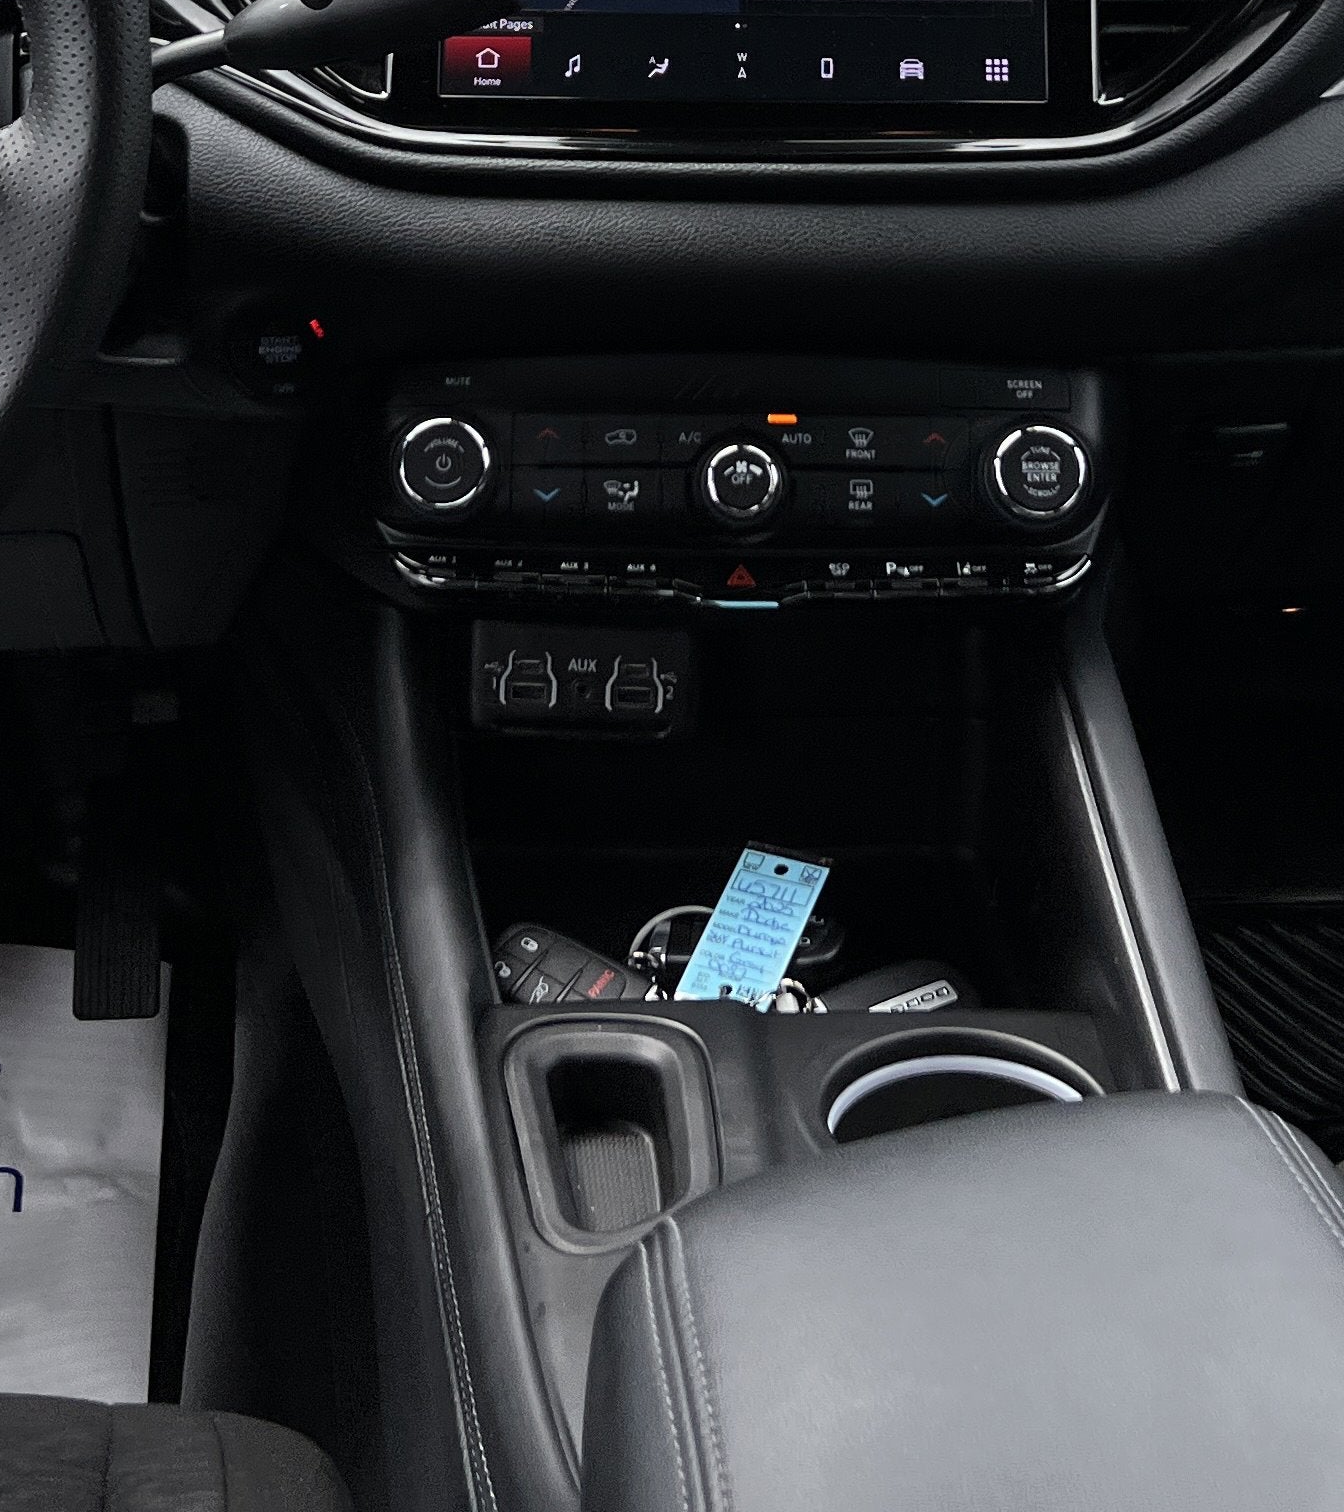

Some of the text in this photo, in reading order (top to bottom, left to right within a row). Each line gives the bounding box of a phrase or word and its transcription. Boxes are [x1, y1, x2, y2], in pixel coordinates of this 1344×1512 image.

[499, 18, 534, 32] Pages
[473, 76, 502, 86] Home
[1006, 379, 1043, 390] SCREEN
[1016, 389, 1035, 399] OFF
[677, 431, 702, 444] A/C
[780, 432, 813, 446] AUTO
[845, 448, 877, 461] FRONT
[848, 500, 874, 512] REAR
[567, 657, 598, 673] AUX
[665, 685, 675, 701] 2
